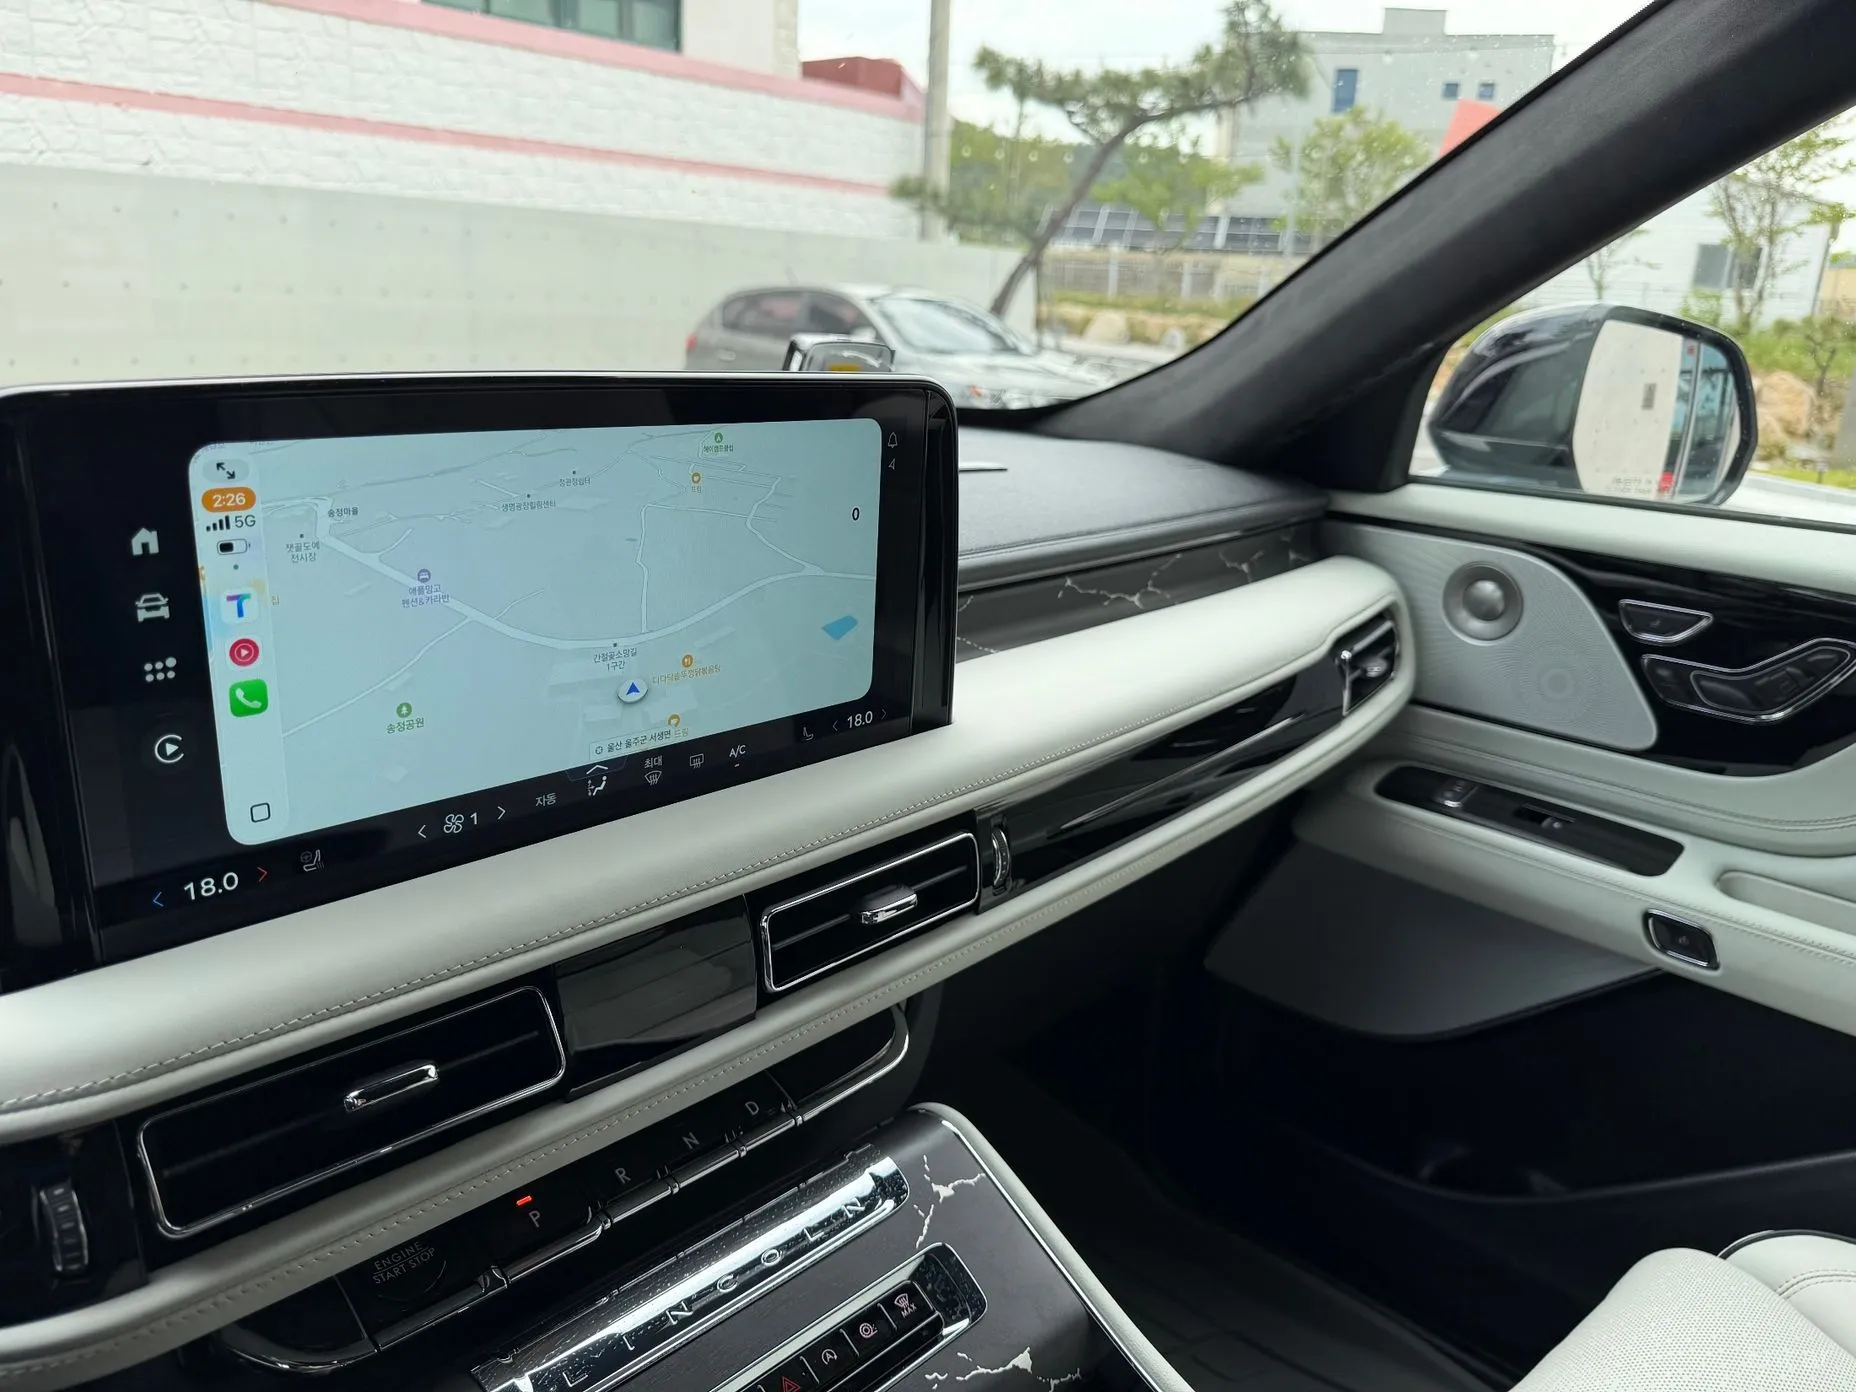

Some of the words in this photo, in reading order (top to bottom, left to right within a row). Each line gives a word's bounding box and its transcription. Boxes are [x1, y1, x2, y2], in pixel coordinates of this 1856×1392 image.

[212, 493, 246, 508] 2:26
[327, 506, 359, 518] 송정마을
[851, 507, 861, 521] 0
[234, 514, 257, 529] 5G
[606, 660, 626, 672] 1구간
[385, 717, 425, 735] 송정공원
[847, 710, 874, 729] 18.0
[729, 744, 746, 759] A/C
[644, 755, 663, 769] 최대
[535, 792, 557, 808] 자동
[470, 812, 478, 825] 1
[183, 871, 240, 901] 18.0
[745, 1101, 760, 1116] D
[683, 1132, 700, 1149] N
[615, 1167, 632, 1184] R
[529, 1210, 542, 1228] P
[374, 1241, 423, 1271] ENGINE
[372, 1263, 407, 1284] START
[408, 1247, 435, 1268] STOP
[562, 1197, 867, 1388] LINCOLN
[901, 1303, 918, 1319] MAX
